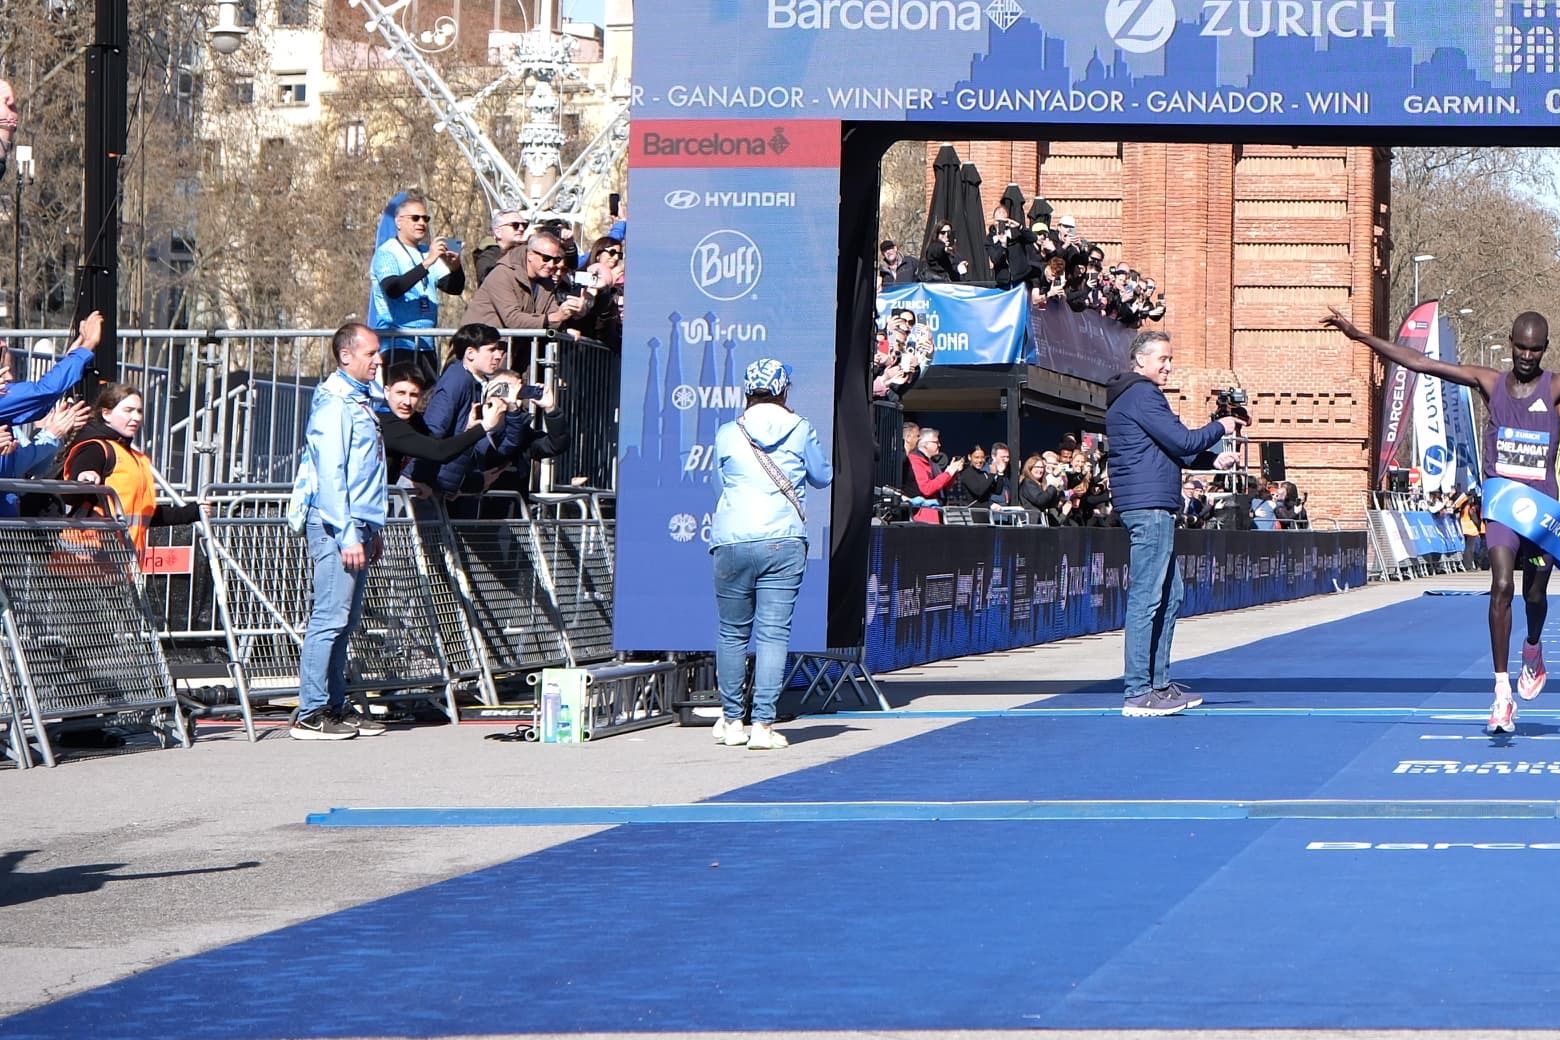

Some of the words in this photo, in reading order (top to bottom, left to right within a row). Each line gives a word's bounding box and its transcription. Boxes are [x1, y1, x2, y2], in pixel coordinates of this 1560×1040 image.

[1200, 0, 1398, 38] ZURICH
[667, 85, 805, 110] GANADOR
[827, 87, 934, 110] WINNER
[956, 89, 1124, 113] GUANYADOR
[1147, 91, 1283, 114] GANADOR
[1305, 92, 1369, 114] WIN
[643, 132, 766, 156] Barcelona
[704, 191, 796, 207] HYUNDAI
[700, 241, 756, 287] Buff
[714, 318, 767, 342] i-run
[1496, 440, 1550, 457] CHELANGAT
